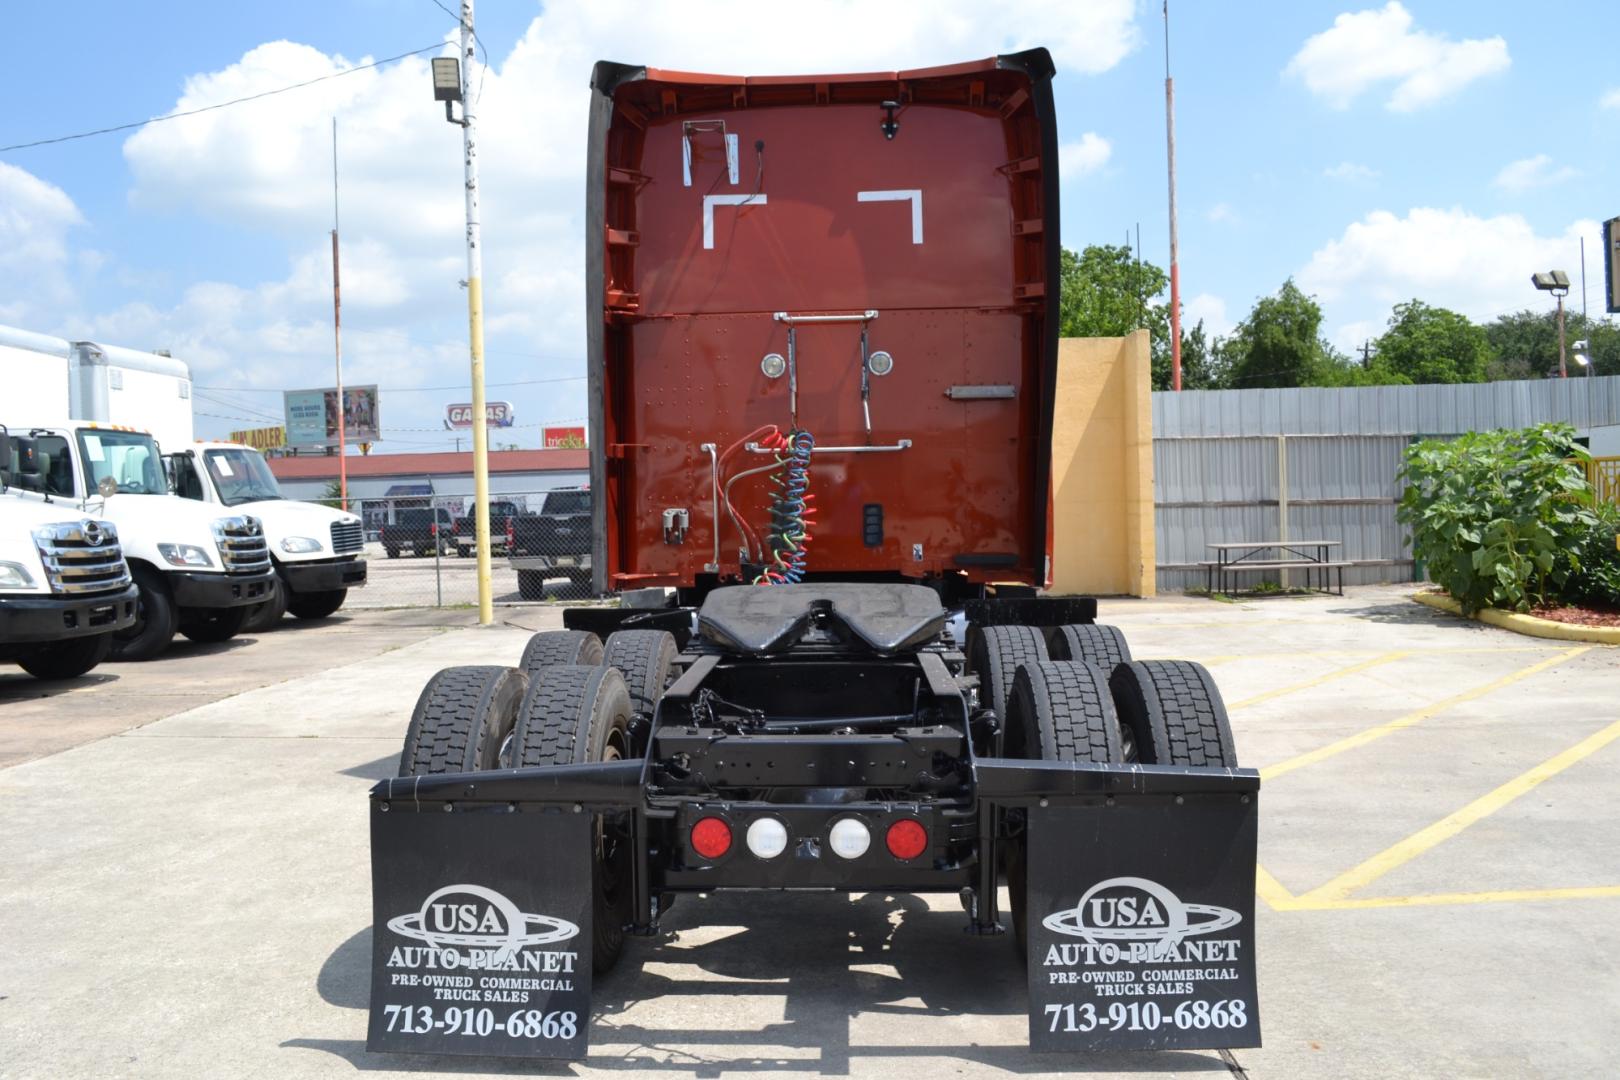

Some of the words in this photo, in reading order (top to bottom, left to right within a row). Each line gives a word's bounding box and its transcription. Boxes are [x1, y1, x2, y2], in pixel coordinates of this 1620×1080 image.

[450, 406, 505, 422] GAAS
[251, 427, 282, 448] ADLER
[432, 903, 504, 933] USA
[1090, 896, 1165, 926] USA
[391, 974, 474, 988] PRE-OWNED
[479, 977, 574, 991] COMMERCIAL
[1049, 970, 1135, 984] PRE-OWNED
[1141, 968, 1239, 982] COMMERCIAL
[434, 988, 481, 1001] TRUCK
[484, 990, 530, 1003] SALES
[1094, 983, 1144, 996] TRUCK
[1147, 982, 1194, 994] SALES
[383, 1004, 577, 1040] 713-910-6868
[1044, 999, 1247, 1033] 713-910-6868
